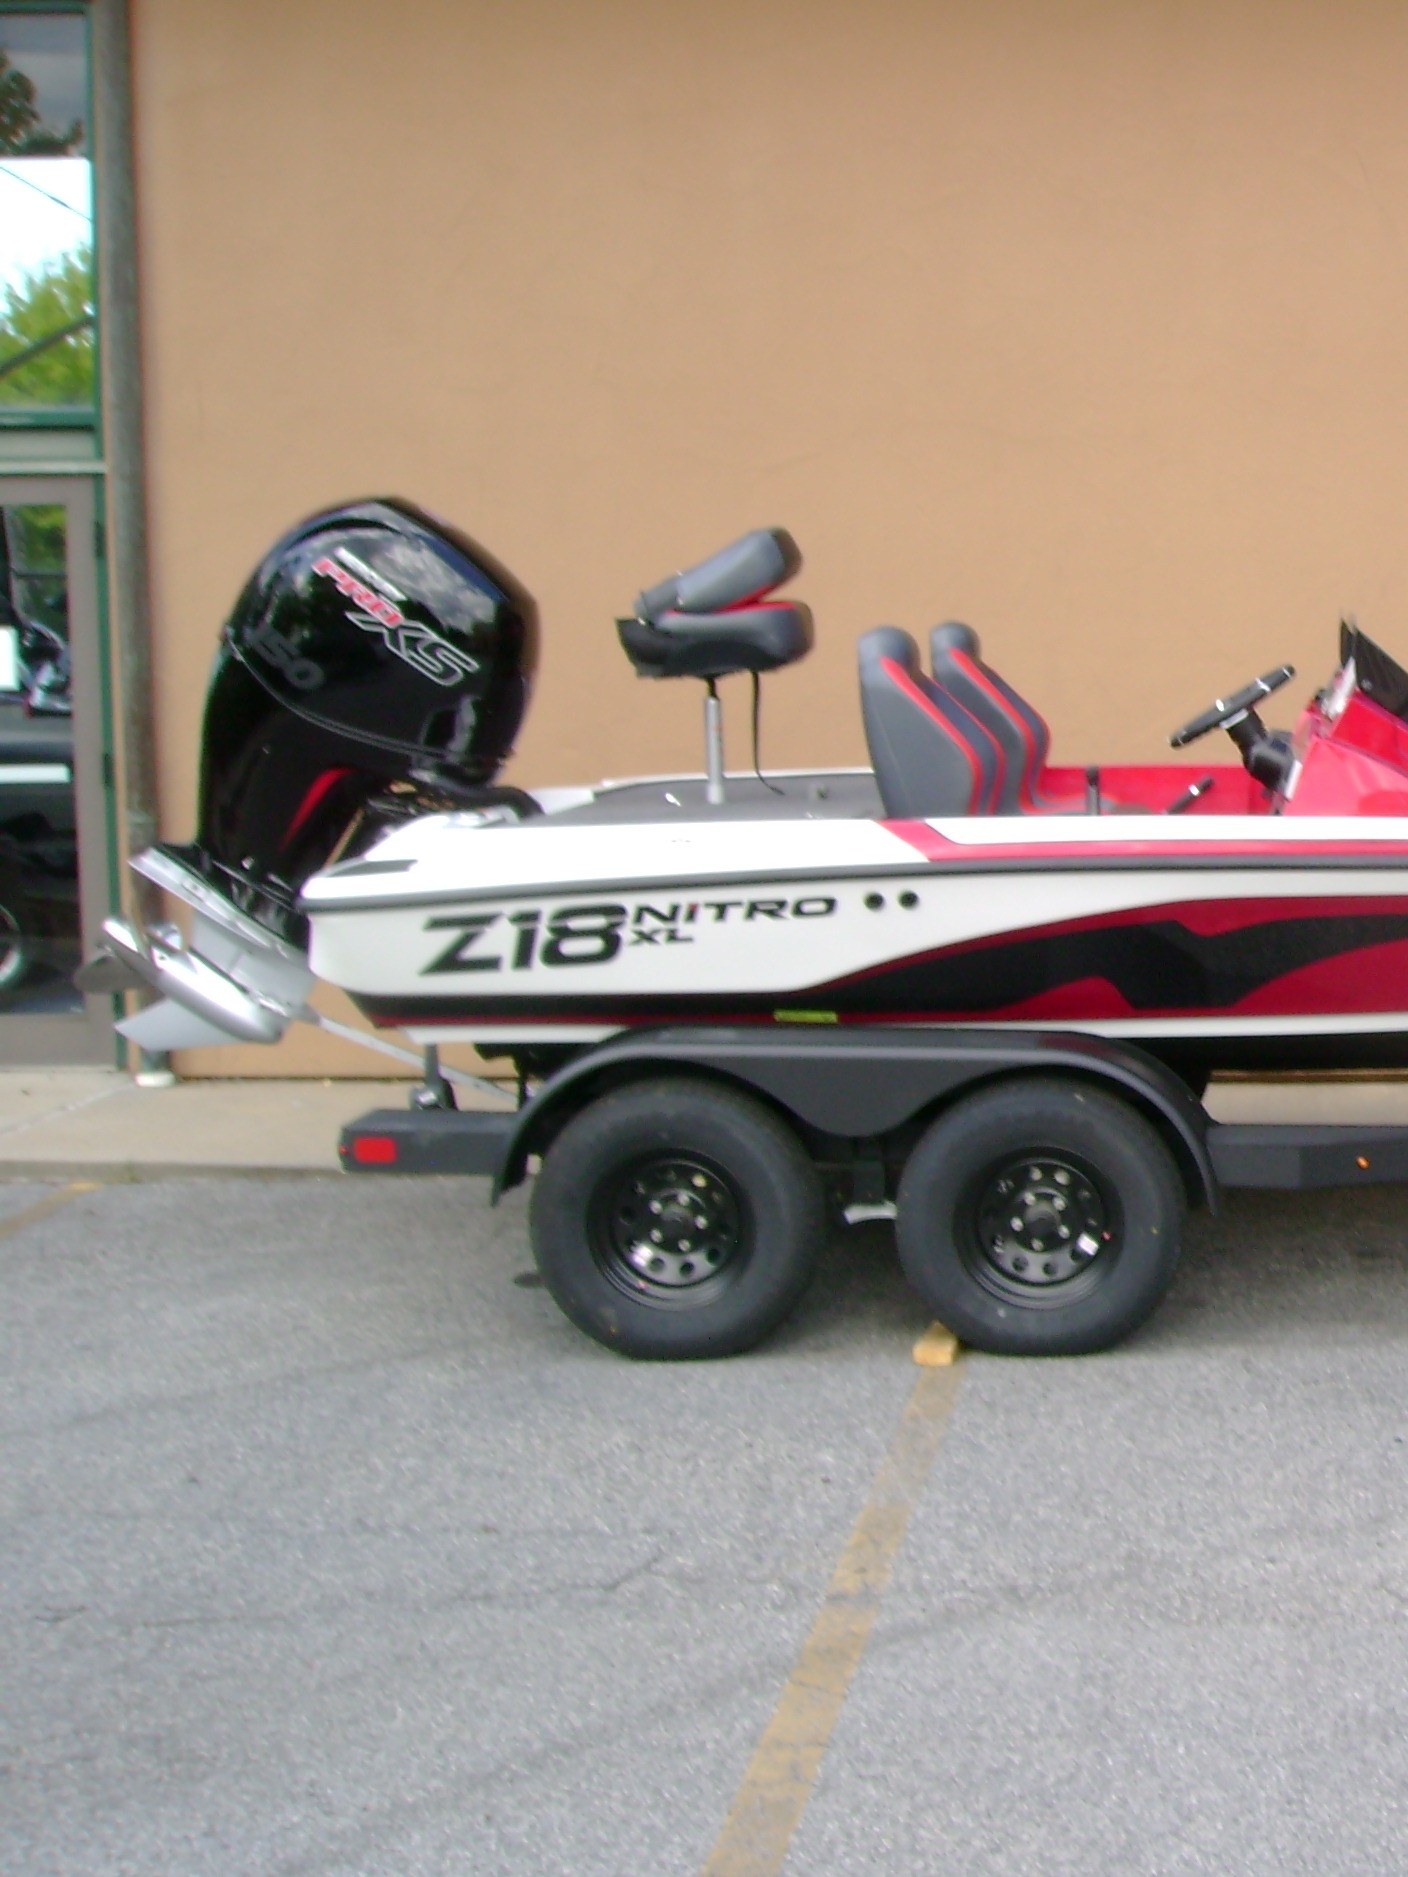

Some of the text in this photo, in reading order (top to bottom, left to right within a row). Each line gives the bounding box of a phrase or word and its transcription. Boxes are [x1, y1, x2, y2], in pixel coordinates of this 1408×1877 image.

[311, 557, 404, 629] PRO
[344, 611, 481, 687] XS
[418, 902, 628, 976] Z18
[628, 926, 695, 947] XL
